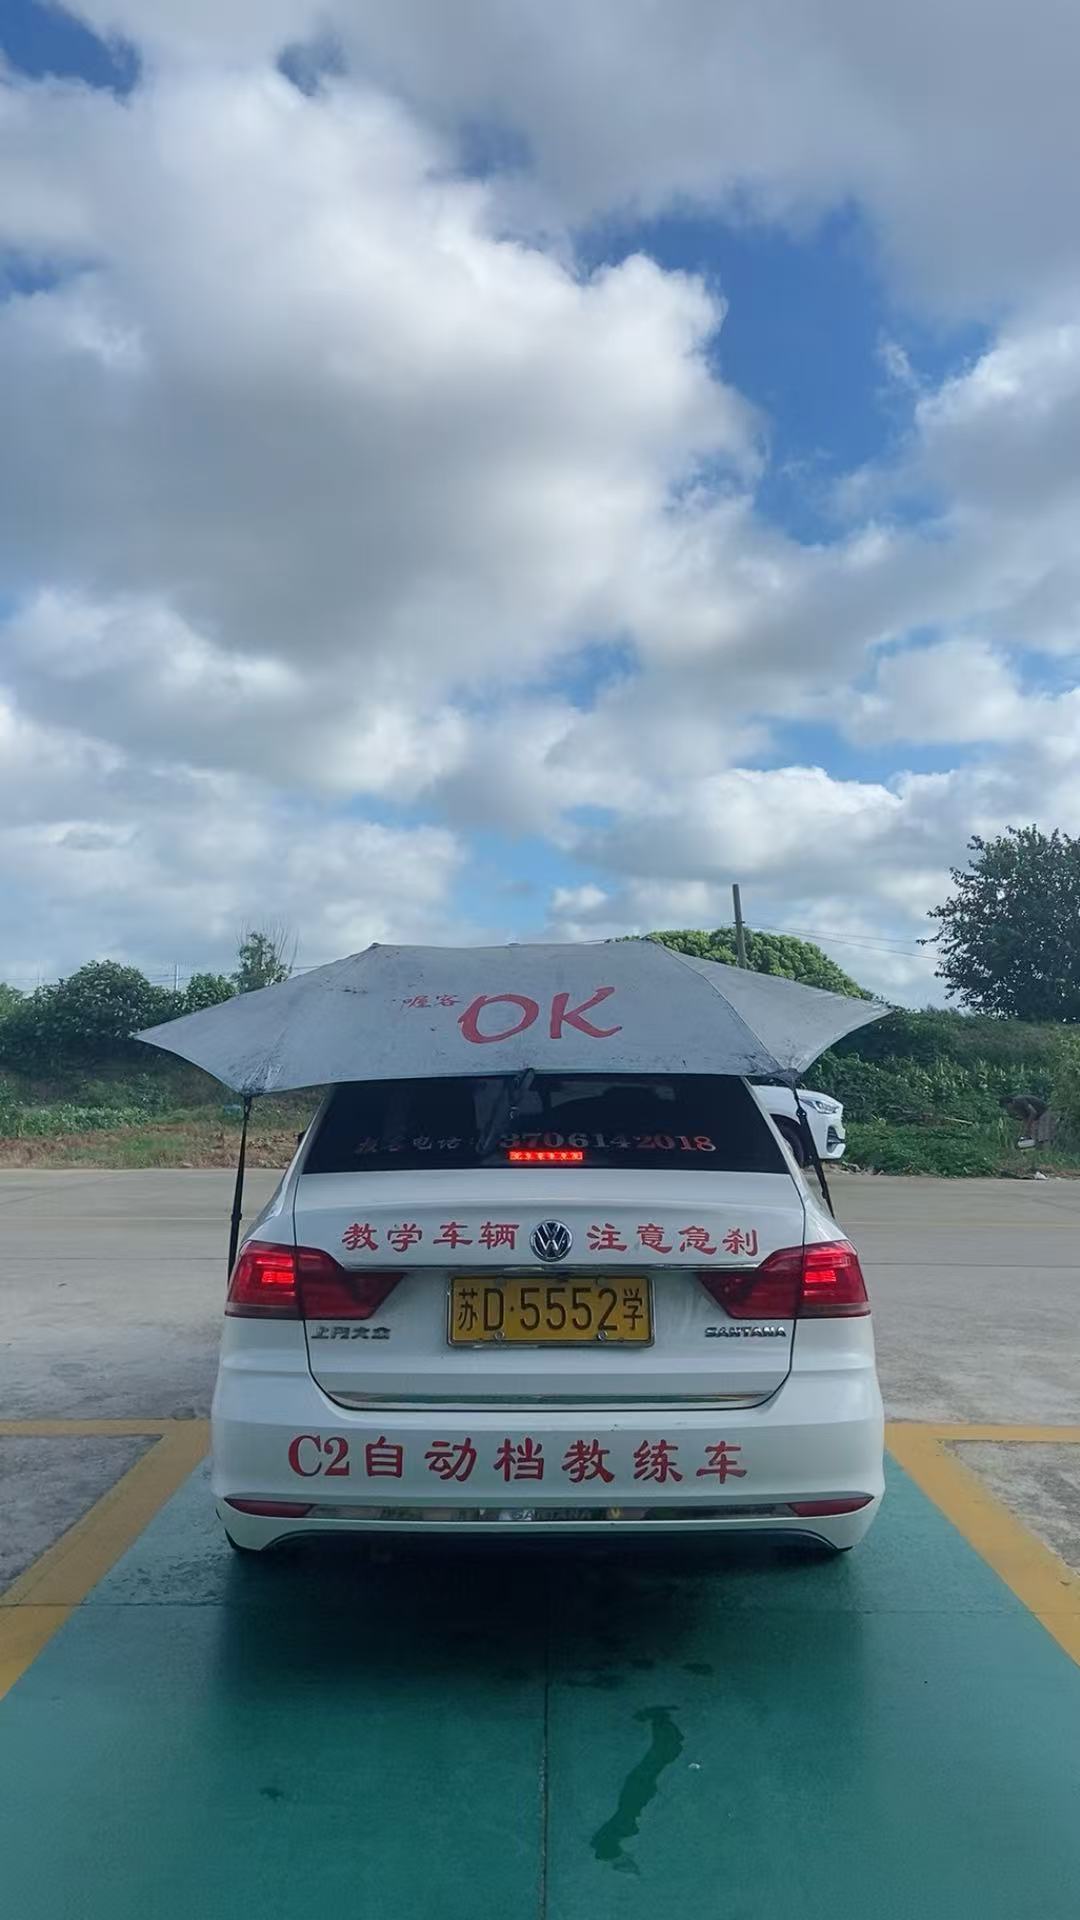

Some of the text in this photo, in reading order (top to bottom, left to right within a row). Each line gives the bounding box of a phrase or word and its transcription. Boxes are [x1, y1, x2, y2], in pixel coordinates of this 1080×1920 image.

[458, 986, 623, 1044] OK
[488, 1132, 716, 1152] 3706142018
[341, 1221, 759, 1256] 教学车辆 注意急刹
[457, 1286, 644, 1332] 苏D·5552学
[704, 1326, 787, 1338] SANTANA
[288, 1434, 748, 1485] C2自动档教练车
